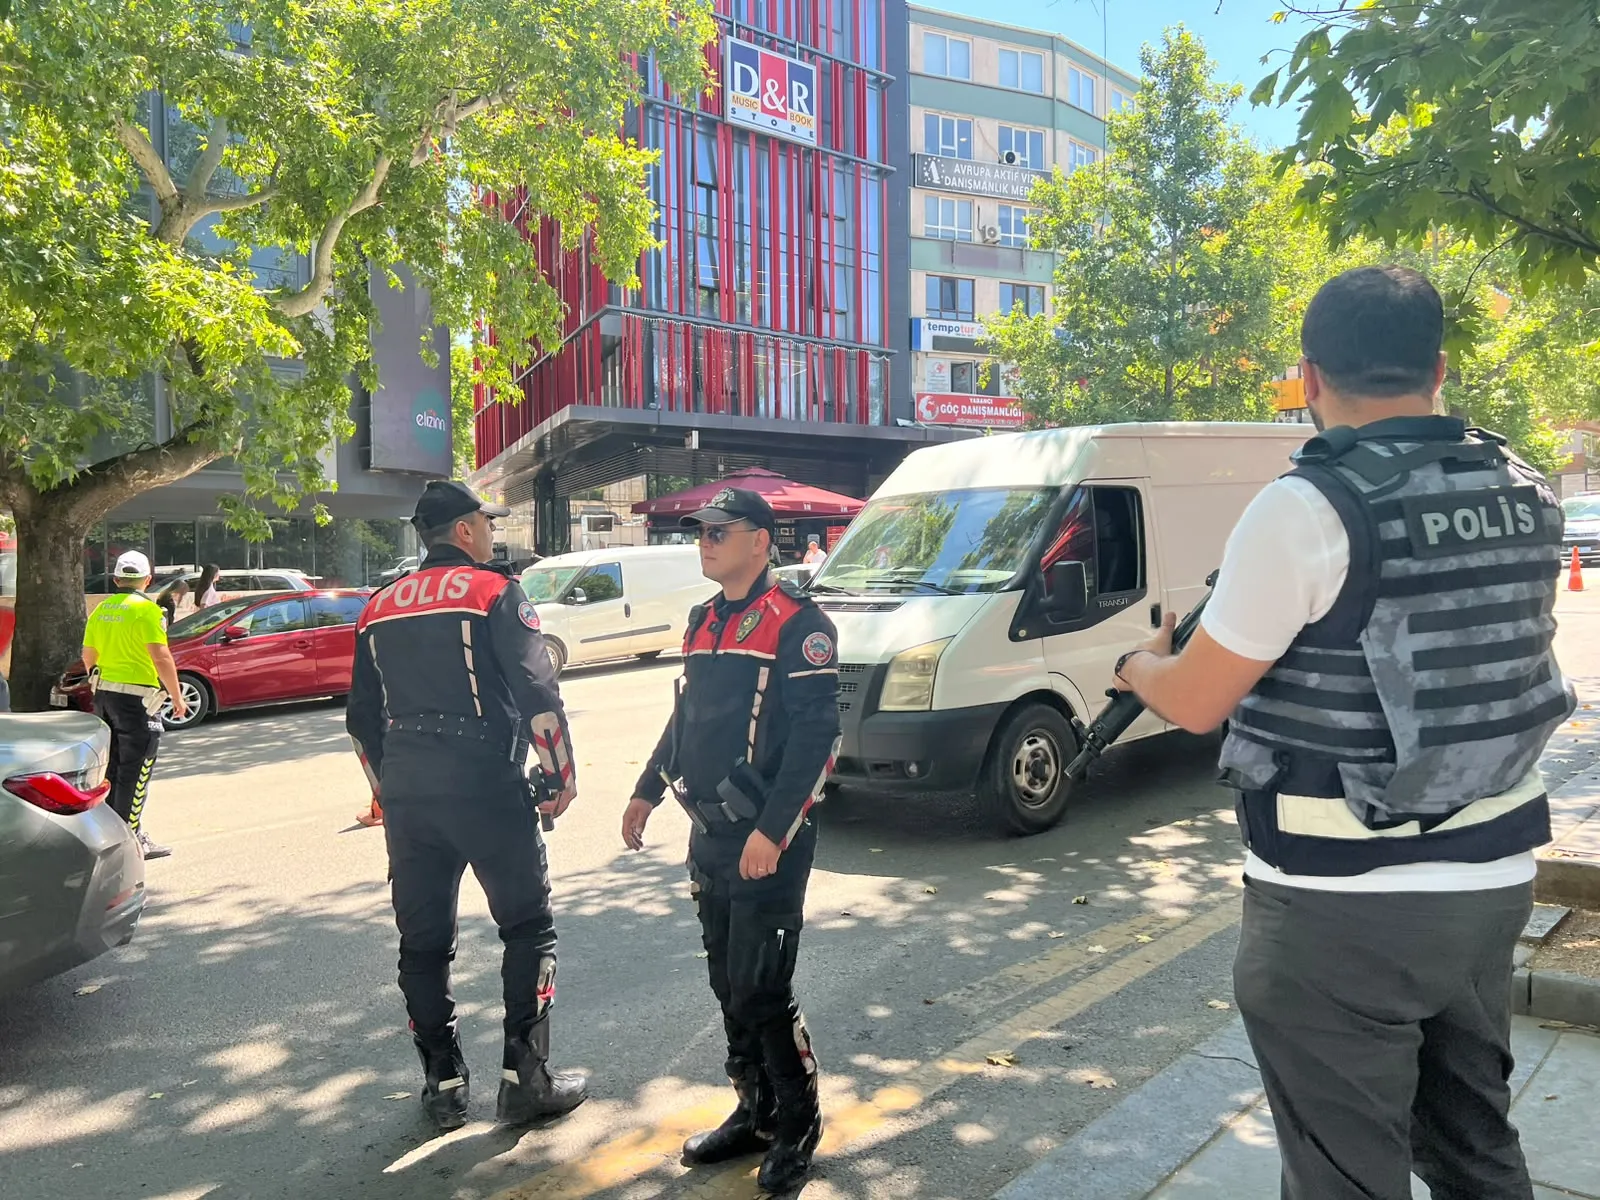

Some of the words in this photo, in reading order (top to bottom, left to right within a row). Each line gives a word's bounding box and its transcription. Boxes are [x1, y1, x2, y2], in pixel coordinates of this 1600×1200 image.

[733, 60, 810, 115] D&R
[730, 107, 814, 138] STORE
[731, 94, 759, 110] MUSIC
[789, 112, 812, 128] BOOK
[944, 176, 1008, 194] DANIŞMANLIK
[953, 163, 991, 178] AVRUPA
[1021, 170, 1040, 184] VİZ
[928, 321, 975, 334] tempotur
[940, 402, 959, 417] GÖÇ
[1421, 495, 1536, 545] POLİS
[374, 570, 472, 613] POLİS
[1098, 597, 1129, 609] TRANSIT
